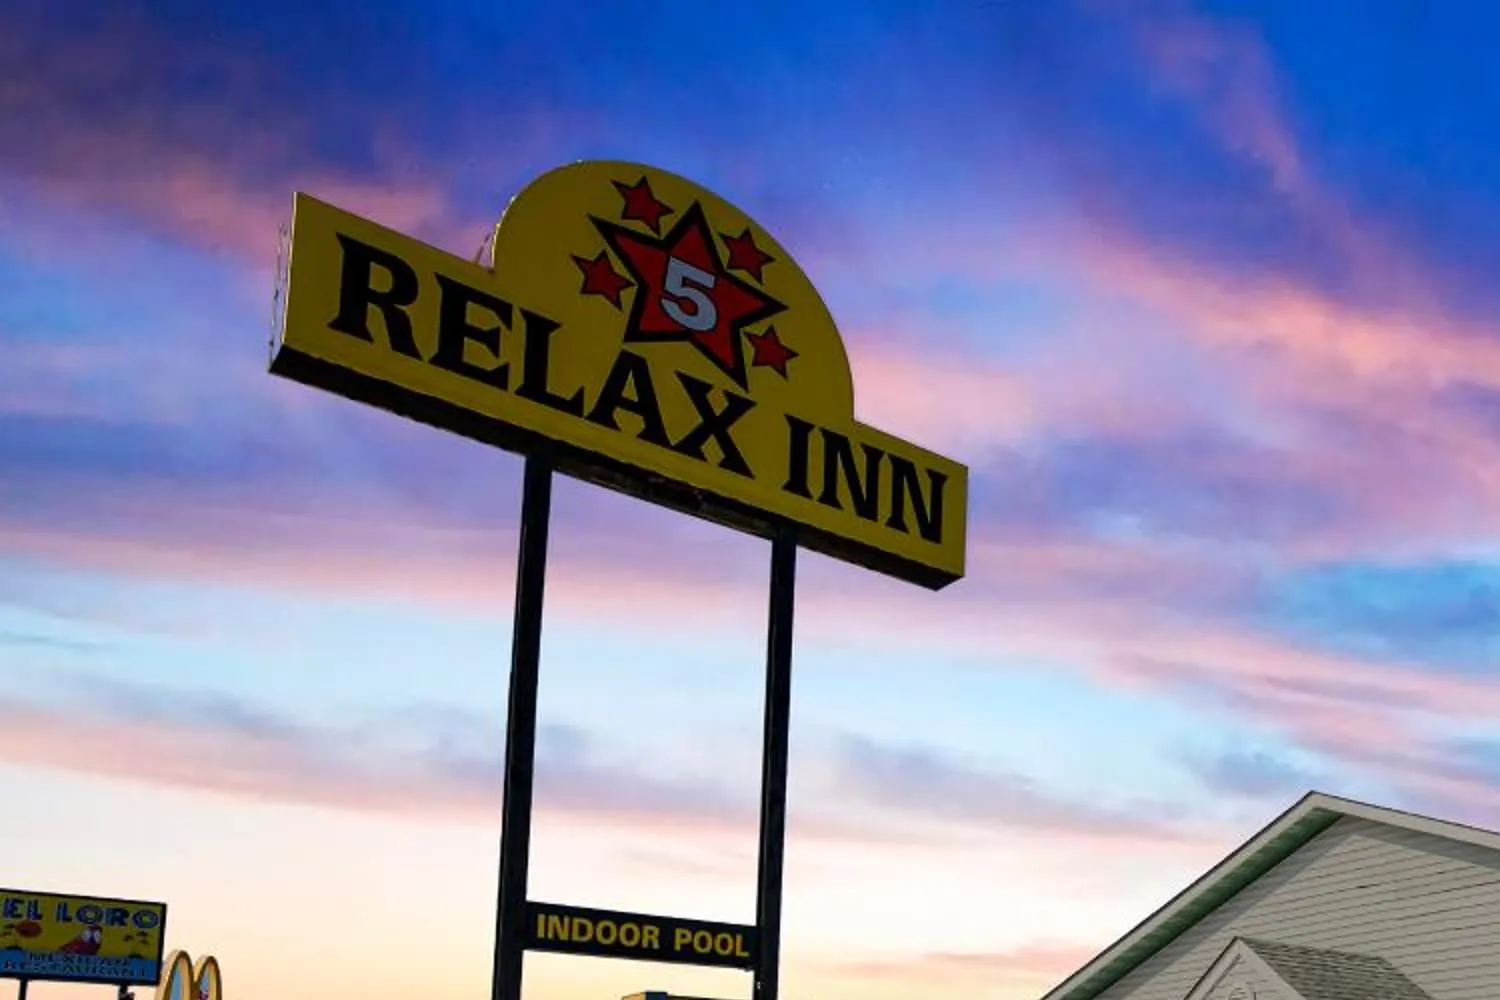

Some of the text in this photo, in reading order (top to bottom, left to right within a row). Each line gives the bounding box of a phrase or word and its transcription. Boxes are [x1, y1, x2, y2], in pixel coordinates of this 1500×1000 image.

[660, 254, 717, 333] 5
[327, 230, 949, 545] RELAX INN
[3, 897, 159, 929] EL LORO
[536, 912, 749, 957] INDOOR POOL
